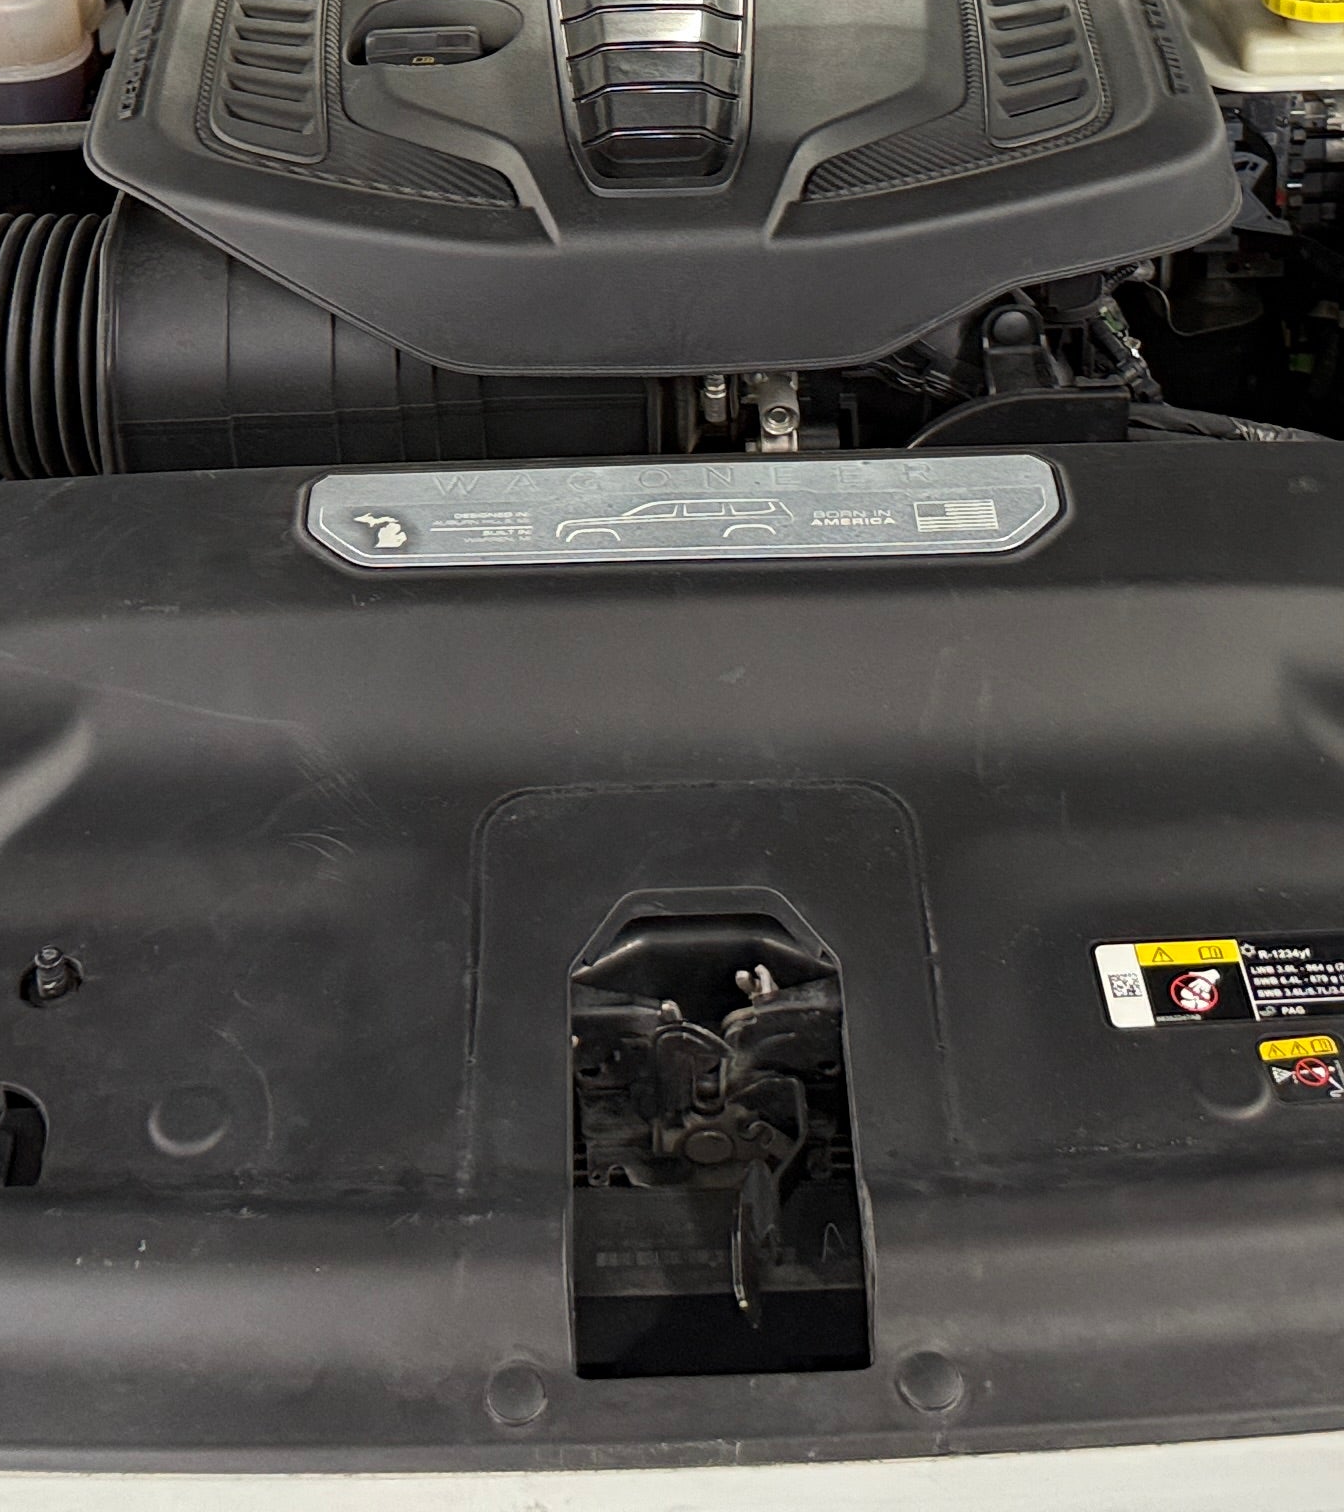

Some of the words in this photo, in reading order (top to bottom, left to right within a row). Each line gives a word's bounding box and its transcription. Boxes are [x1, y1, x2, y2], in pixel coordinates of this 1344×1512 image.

[433, 462, 932, 496] WAGONEER
[453, 511, 514, 519] DESIGNED
[813, 509, 867, 519] BORN
[873, 509, 892, 517] IN
[810, 517, 896, 527] AMERICA
[1257, 947, 1312, 960] R-1234yf
[1281, 1005, 1306, 1016] PAG
